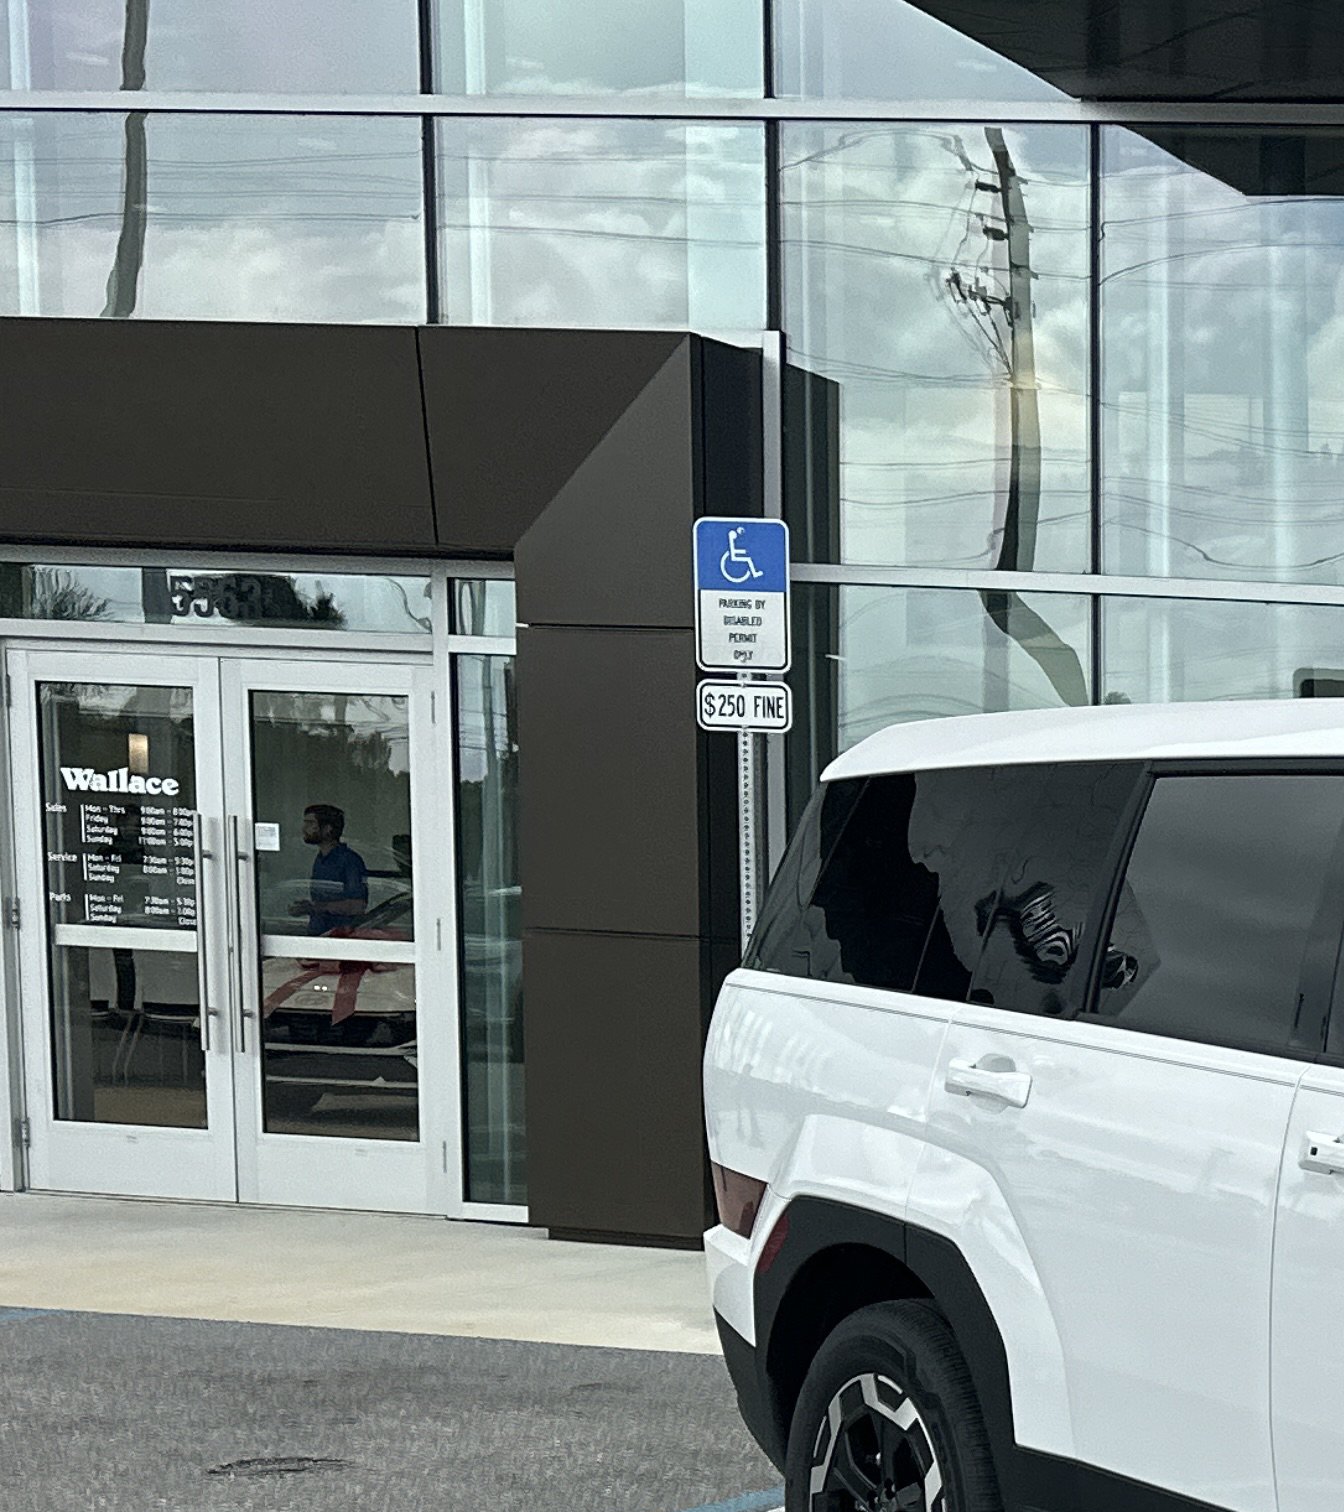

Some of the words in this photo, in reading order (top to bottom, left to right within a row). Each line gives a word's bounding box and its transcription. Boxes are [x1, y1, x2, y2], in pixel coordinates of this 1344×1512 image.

[719, 598, 753, 609] PARKING
[755, 599, 766, 610] BY
[723, 616, 762, 626] DISABLED
[729, 633, 757, 643] PERMIT
[704, 692, 745, 718] $250
[753, 696, 784, 719] FINE
[60, 767, 180, 796] Wallace
[87, 824, 118, 836] Saturday
[87, 835, 113, 845] Sunday
[48, 852, 78, 862] Service
[88, 863, 120, 874] Saturday
[89, 873, 115, 883] Sunday
[90, 903, 122, 914] Saturday
